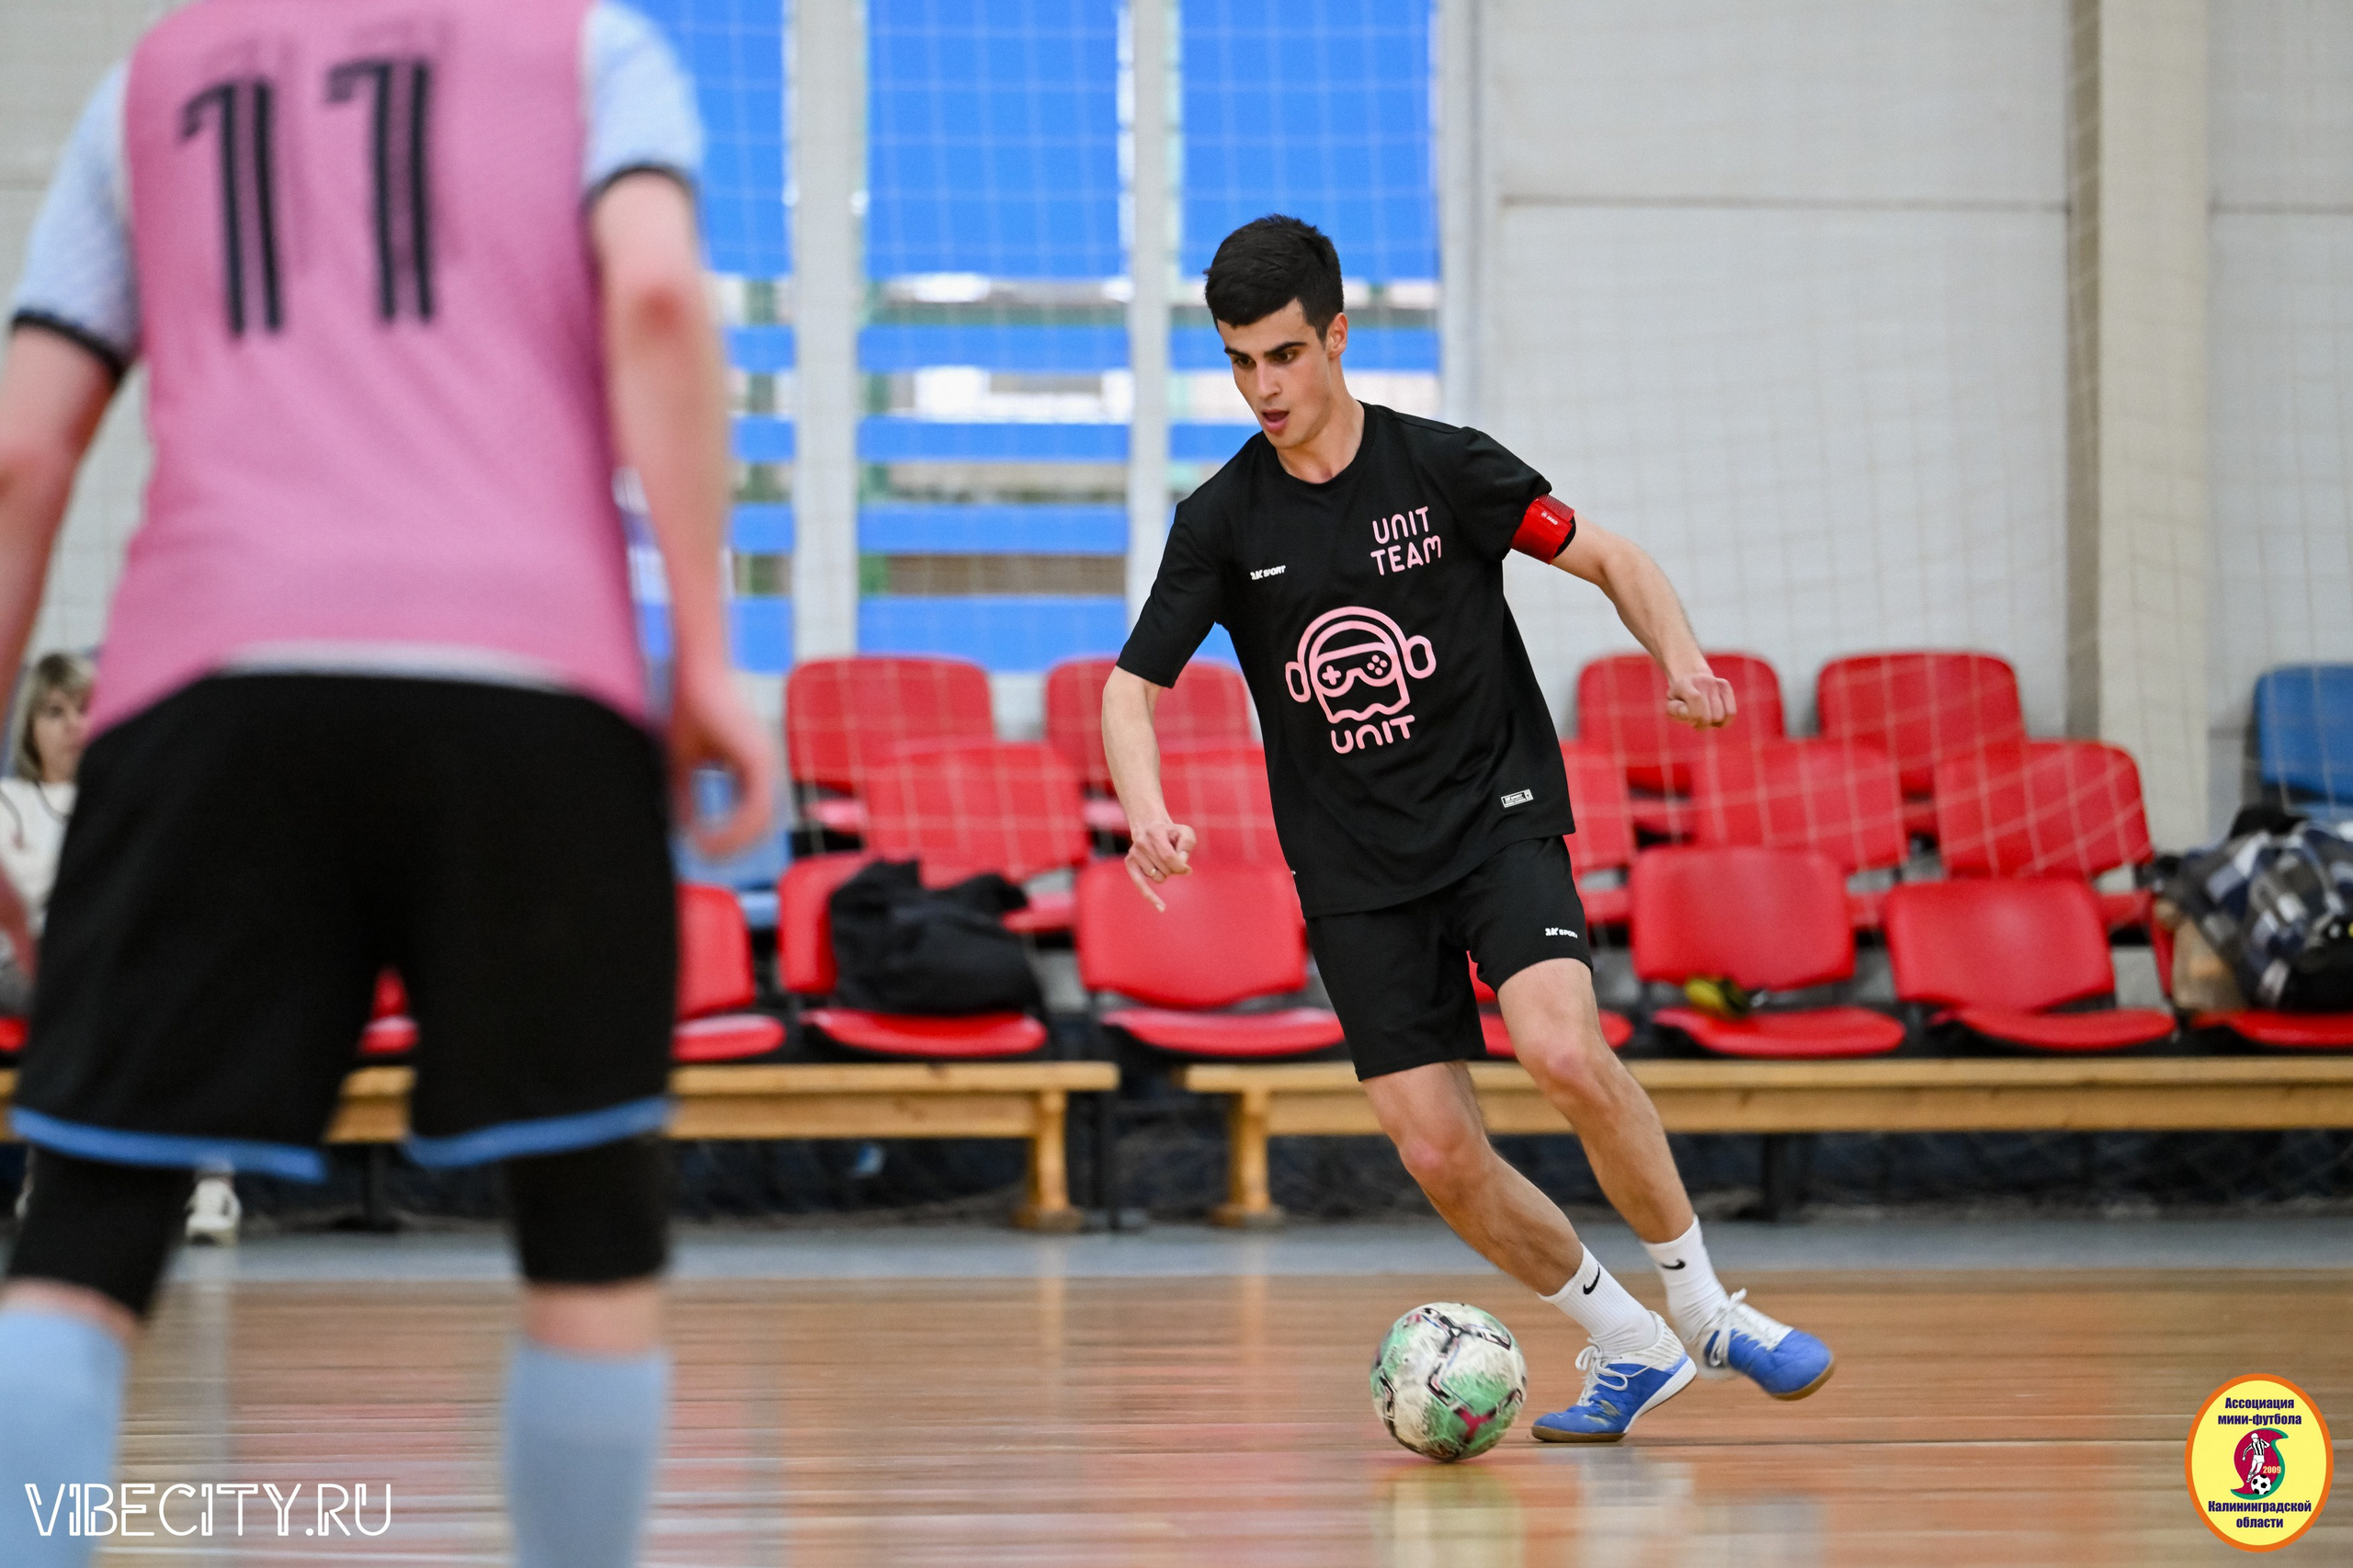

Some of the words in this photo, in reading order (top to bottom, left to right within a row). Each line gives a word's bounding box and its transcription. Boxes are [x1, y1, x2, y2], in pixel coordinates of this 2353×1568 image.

[178, 57, 435, 336] 11
[1372, 506, 1429, 544] UNIT
[1263, 564, 1287, 578] SPORT
[1370, 535, 1441, 575] TEAM
[1330, 714, 1415, 754] UNIT
